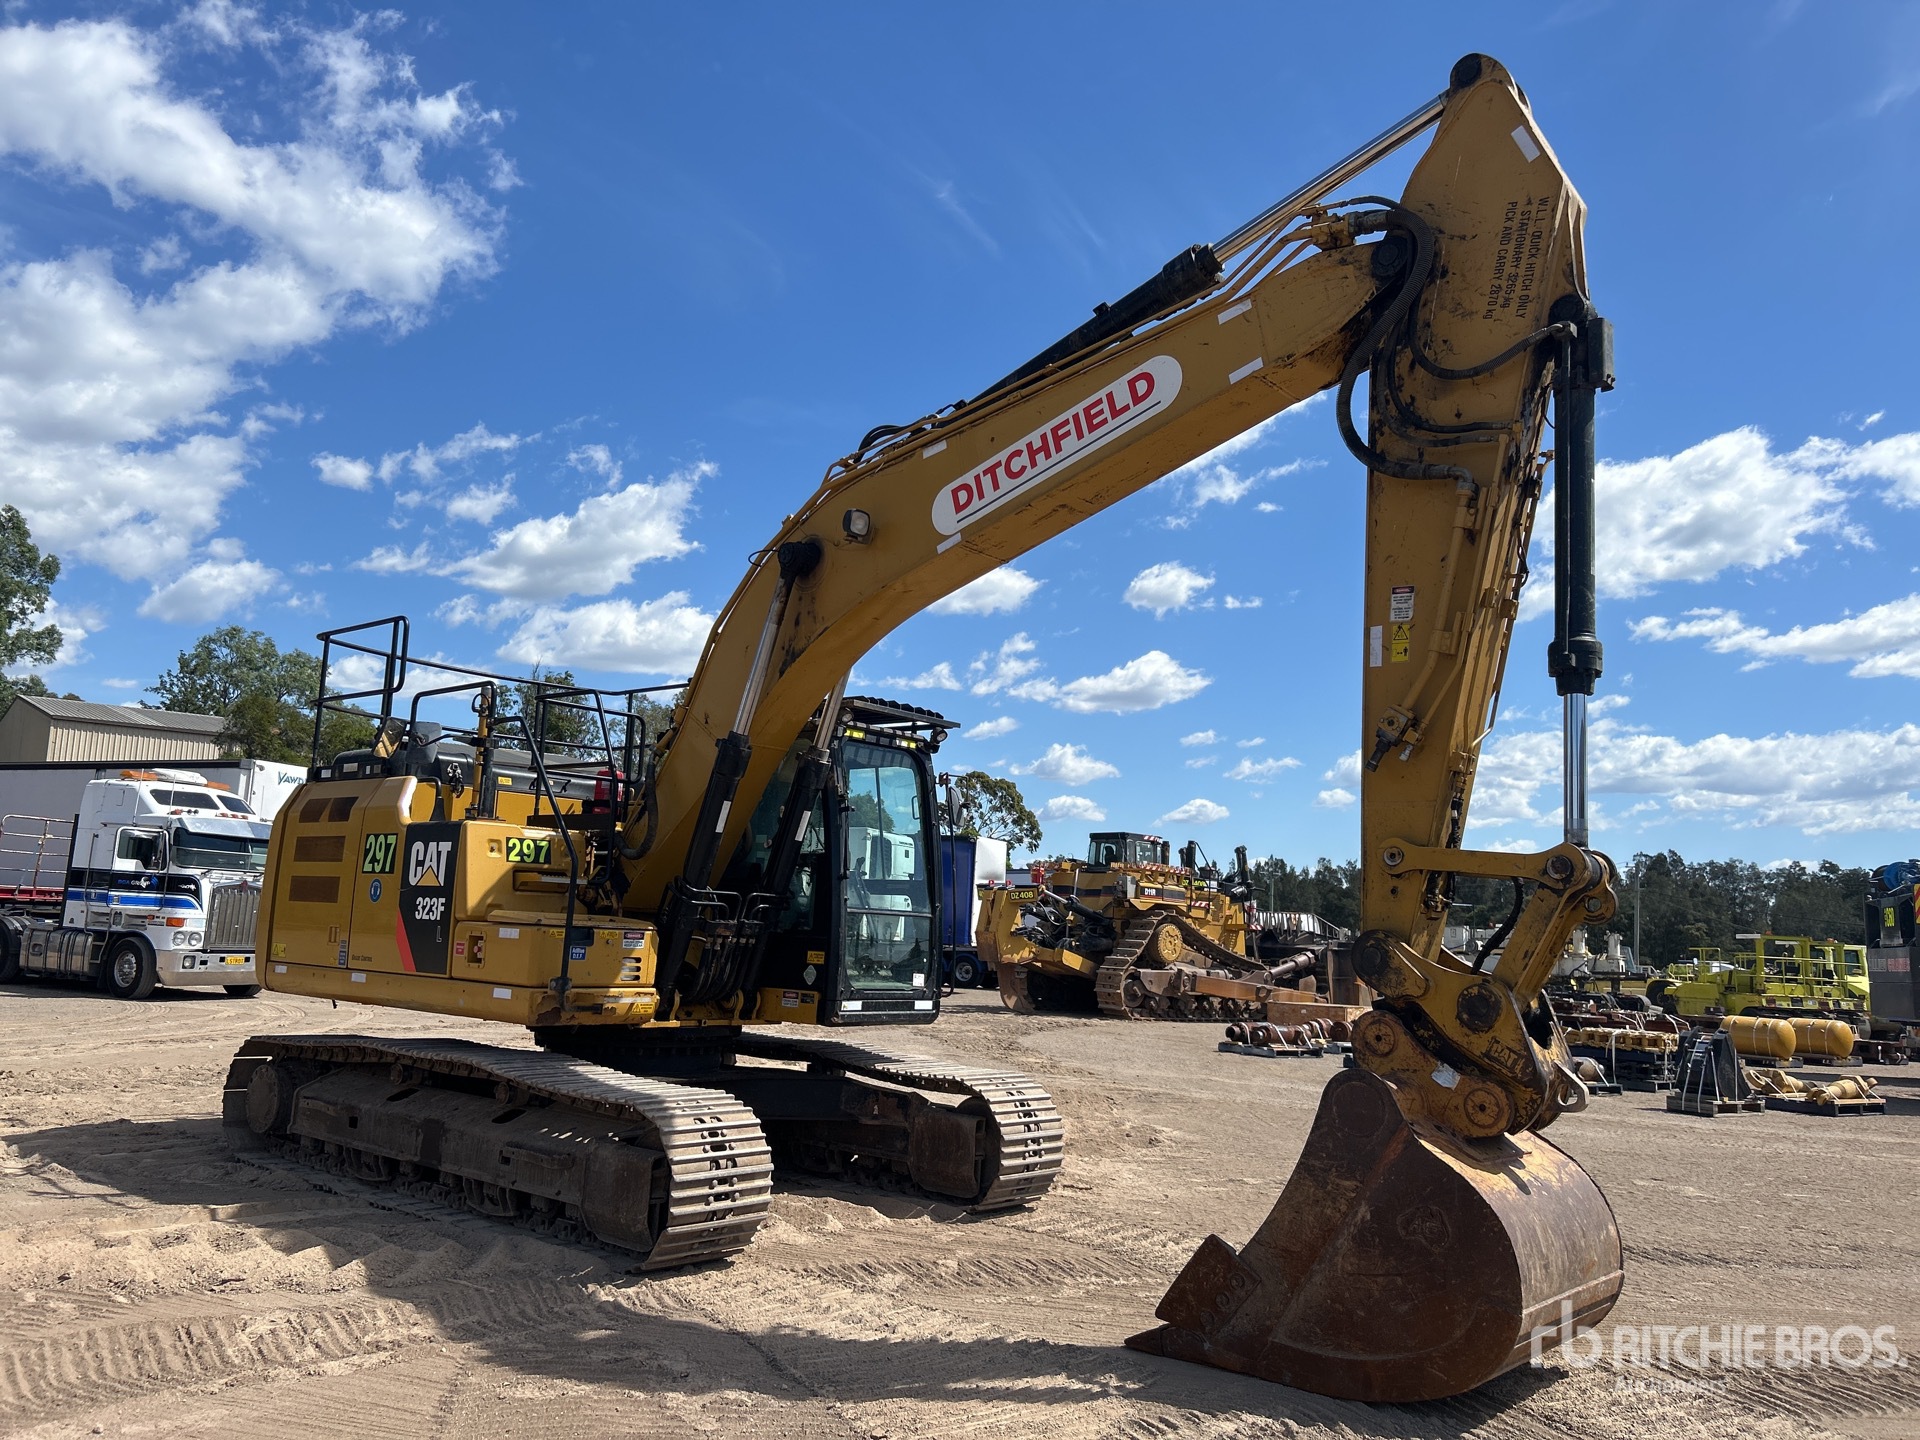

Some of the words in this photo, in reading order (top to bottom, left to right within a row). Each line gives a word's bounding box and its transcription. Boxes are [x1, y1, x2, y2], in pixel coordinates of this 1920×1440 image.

[1503, 201, 1518, 223] PICK
[1499, 226, 1511, 246] AND
[1529, 230, 1543, 260] QUICK
[1493, 248, 1509, 281] CARRY
[1521, 262, 1536, 291] HITCH
[1487, 283, 1502, 307] 2870
[1515, 294, 1530, 319] ONLY
[1482, 309, 1494, 320] kg
[950, 371, 1156, 516] DITCHFIELD
[363, 833, 398, 873] 297
[507, 837, 550, 863] 297
[408, 841, 452, 886] CAT
[414, 897, 446, 921] 323F
[435, 925, 443, 943] L
